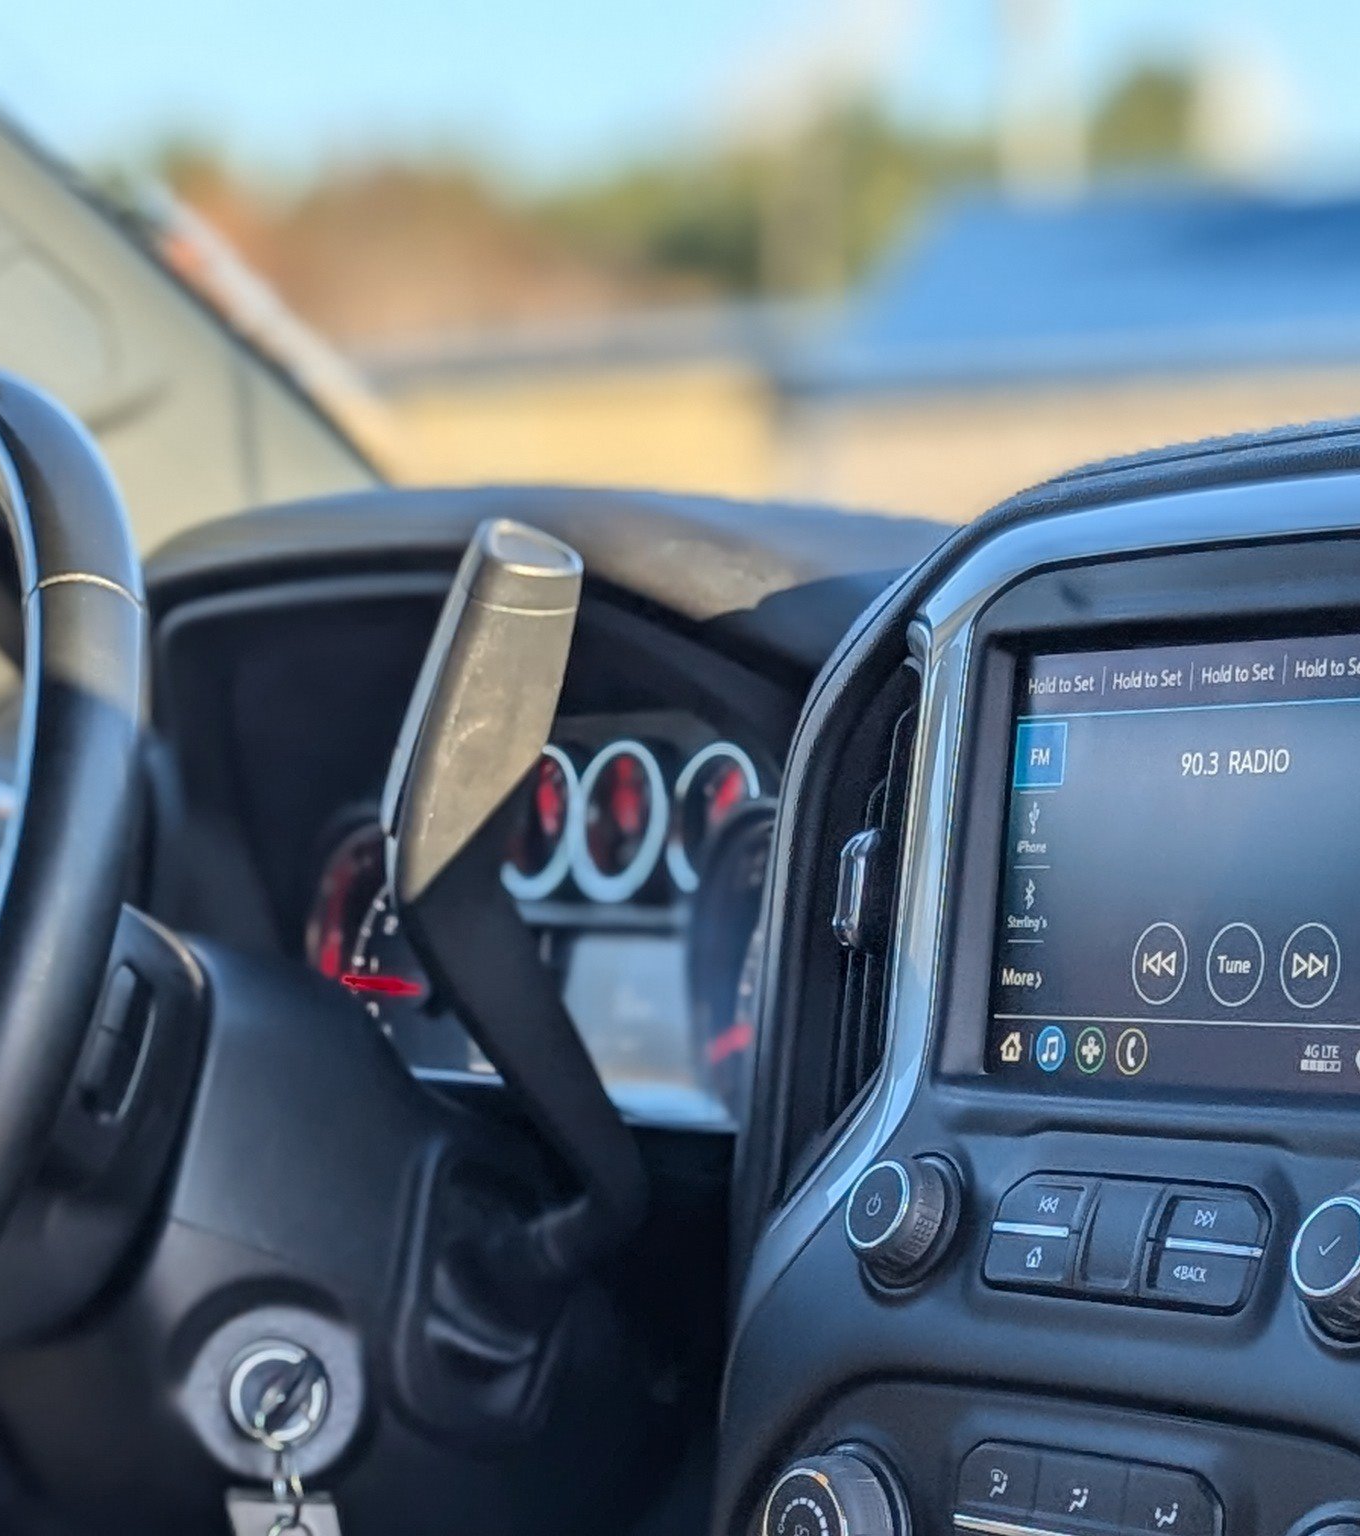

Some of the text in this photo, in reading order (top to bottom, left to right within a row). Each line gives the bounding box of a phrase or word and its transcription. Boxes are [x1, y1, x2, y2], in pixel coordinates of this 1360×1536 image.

[1201, 663, 1275, 685] Hold to Set
[1294, 658, 1327, 678] Hold
[1330, 659, 1345, 676] to
[1028, 674, 1095, 695] Hold to Set
[1112, 669, 1183, 690] Hold to Set
[1030, 747, 1051, 766] FM
[1181, 748, 1290, 776] 90.3 RADIO
[1217, 954, 1252, 974] Tune
[1001, 967, 1035, 986] More
[1303, 1044, 1340, 1059] 4G LTE
[1180, 1265, 1208, 1283] BACK
